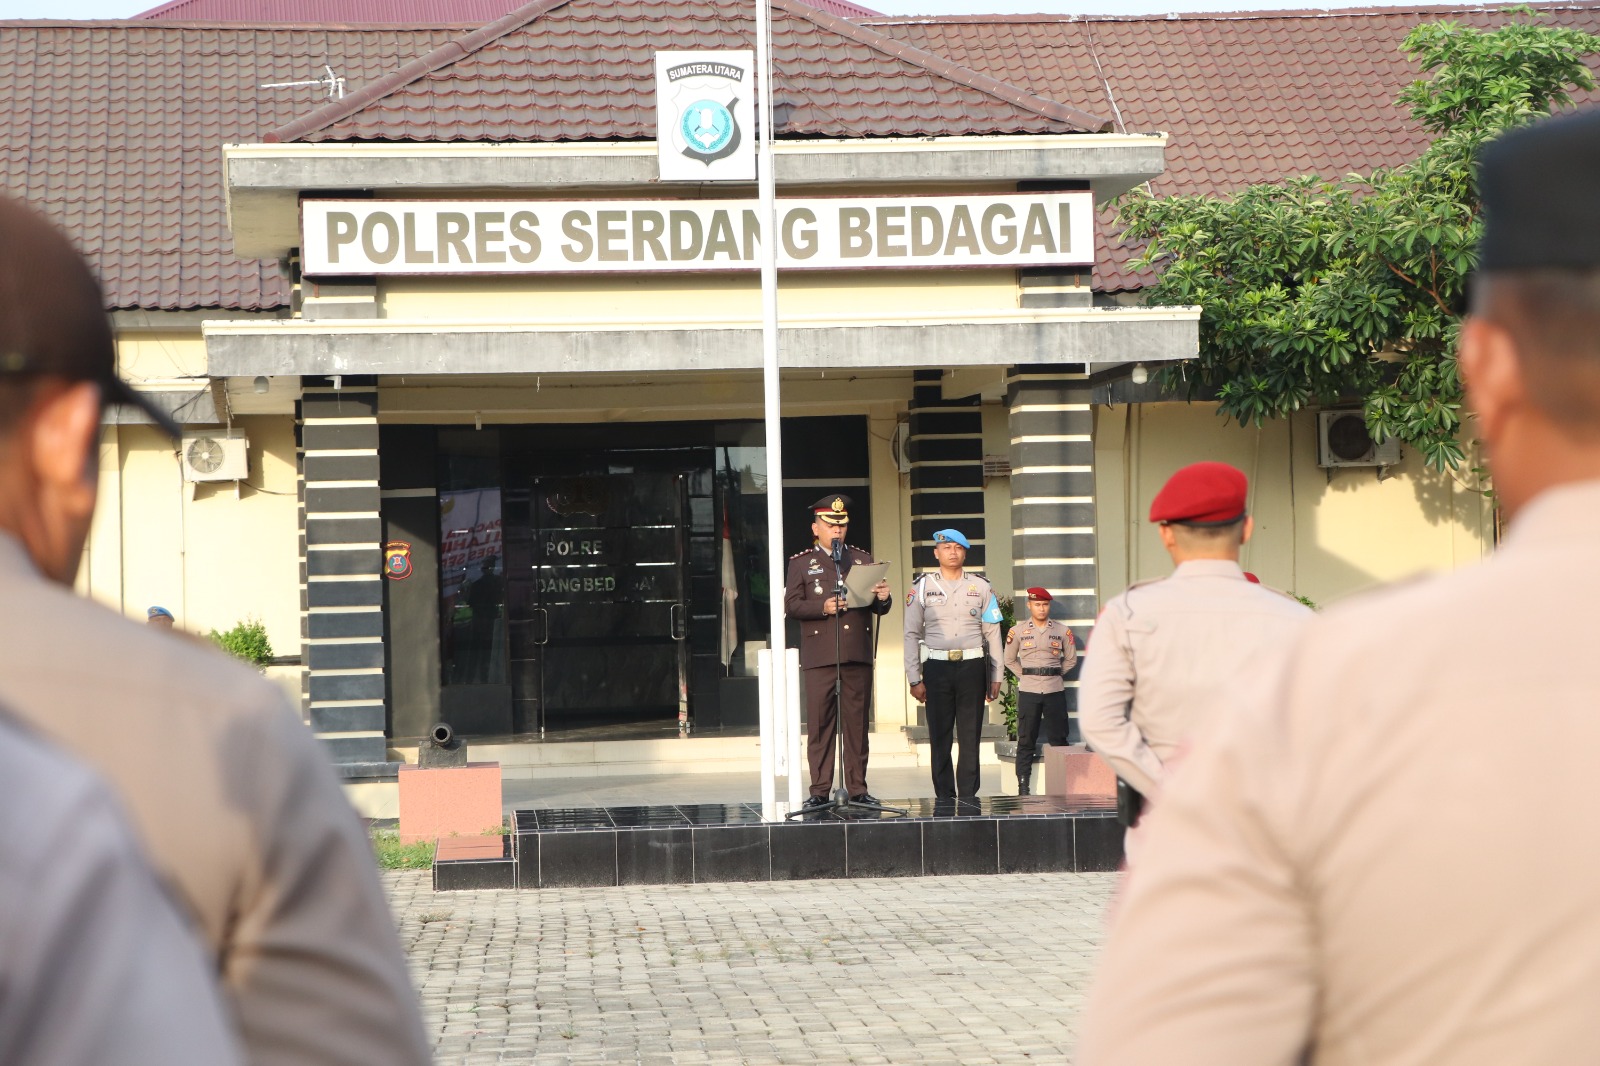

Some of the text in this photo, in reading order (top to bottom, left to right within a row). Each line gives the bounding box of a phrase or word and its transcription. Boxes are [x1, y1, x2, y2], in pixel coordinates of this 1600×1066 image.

[669, 64, 741, 80] SUMATERA UTARA
[326, 210, 542, 264] POLRES
[838, 202, 1072, 258] BEDAGAI
